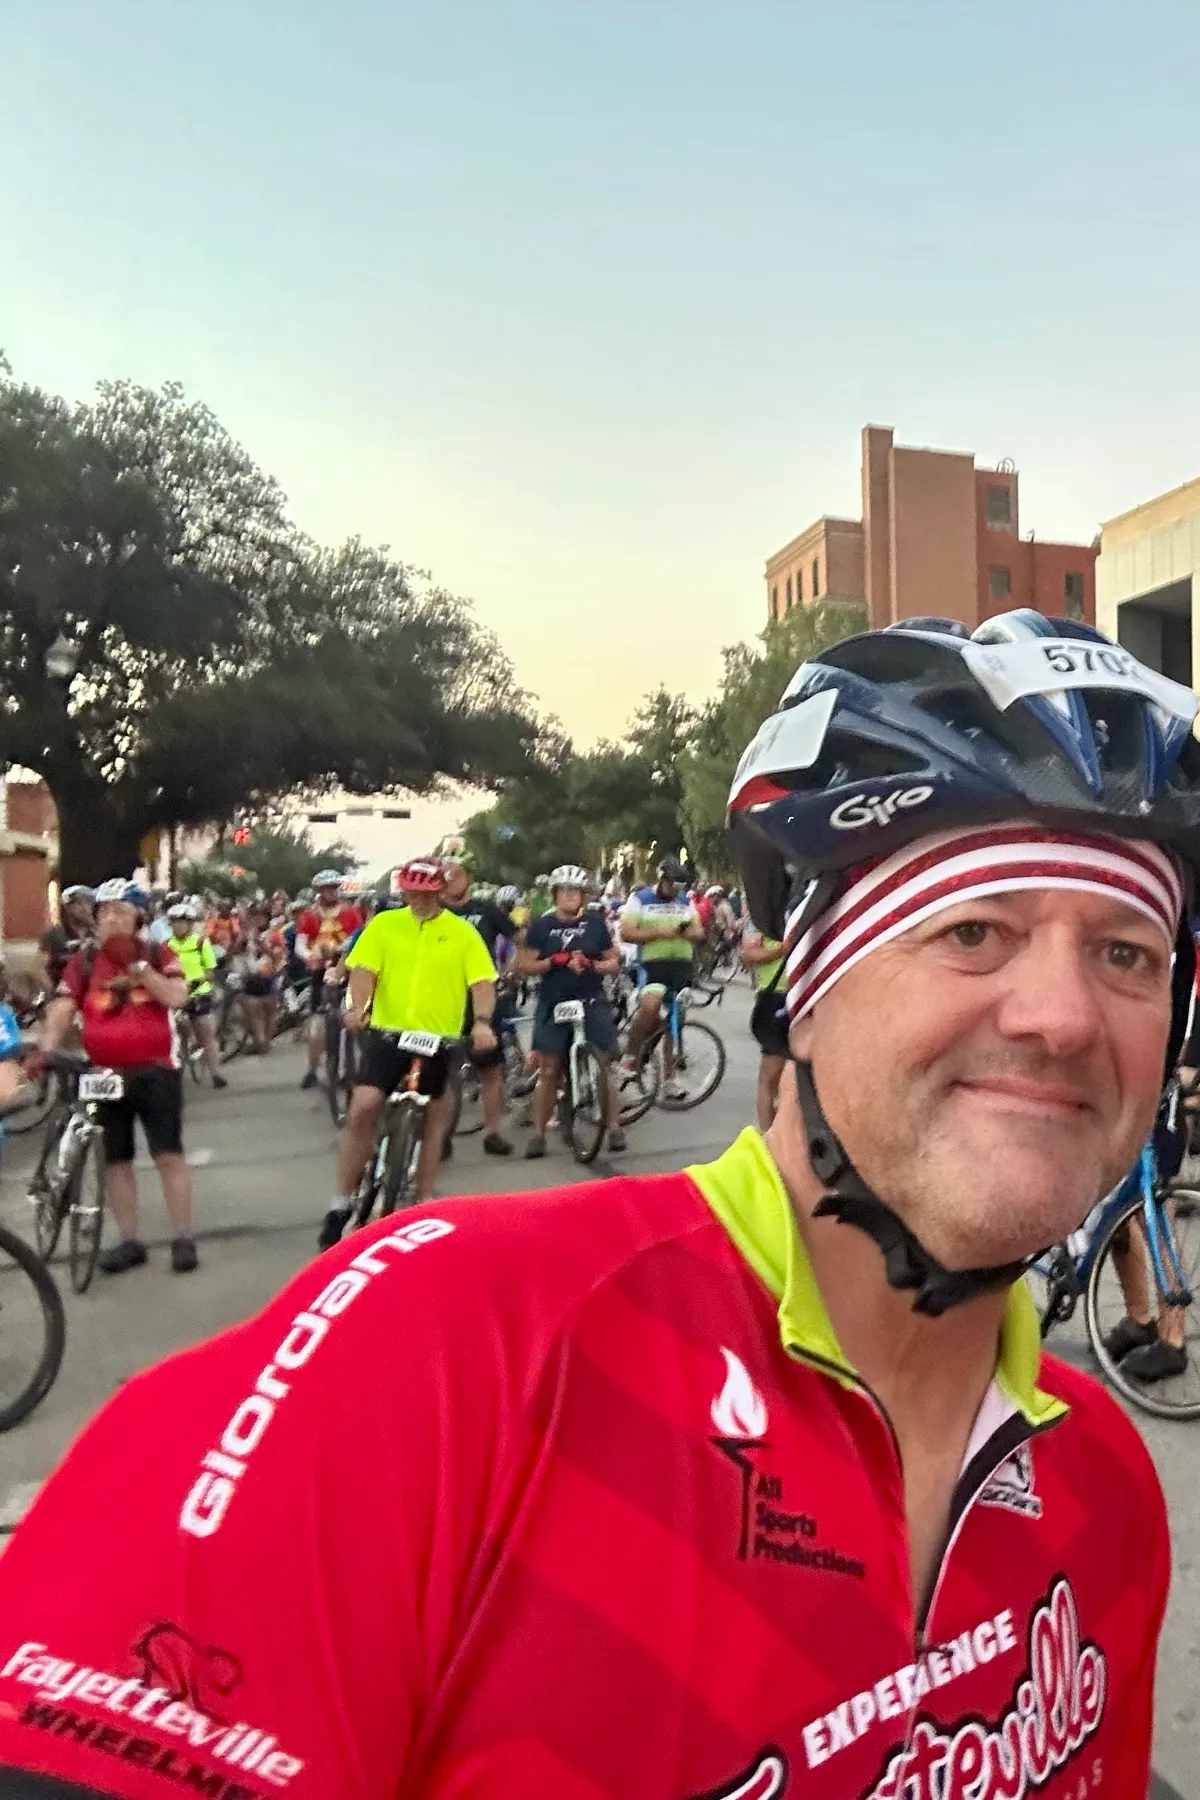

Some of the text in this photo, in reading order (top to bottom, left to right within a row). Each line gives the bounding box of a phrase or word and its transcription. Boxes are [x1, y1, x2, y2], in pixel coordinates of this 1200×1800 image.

[829, 785, 934, 830] Giro
[756, 1473, 783, 1500] All
[755, 1503, 817, 1538] Sports
[754, 1534, 867, 1578] Productions
[0, 1641, 305, 1788] Fayetteville
